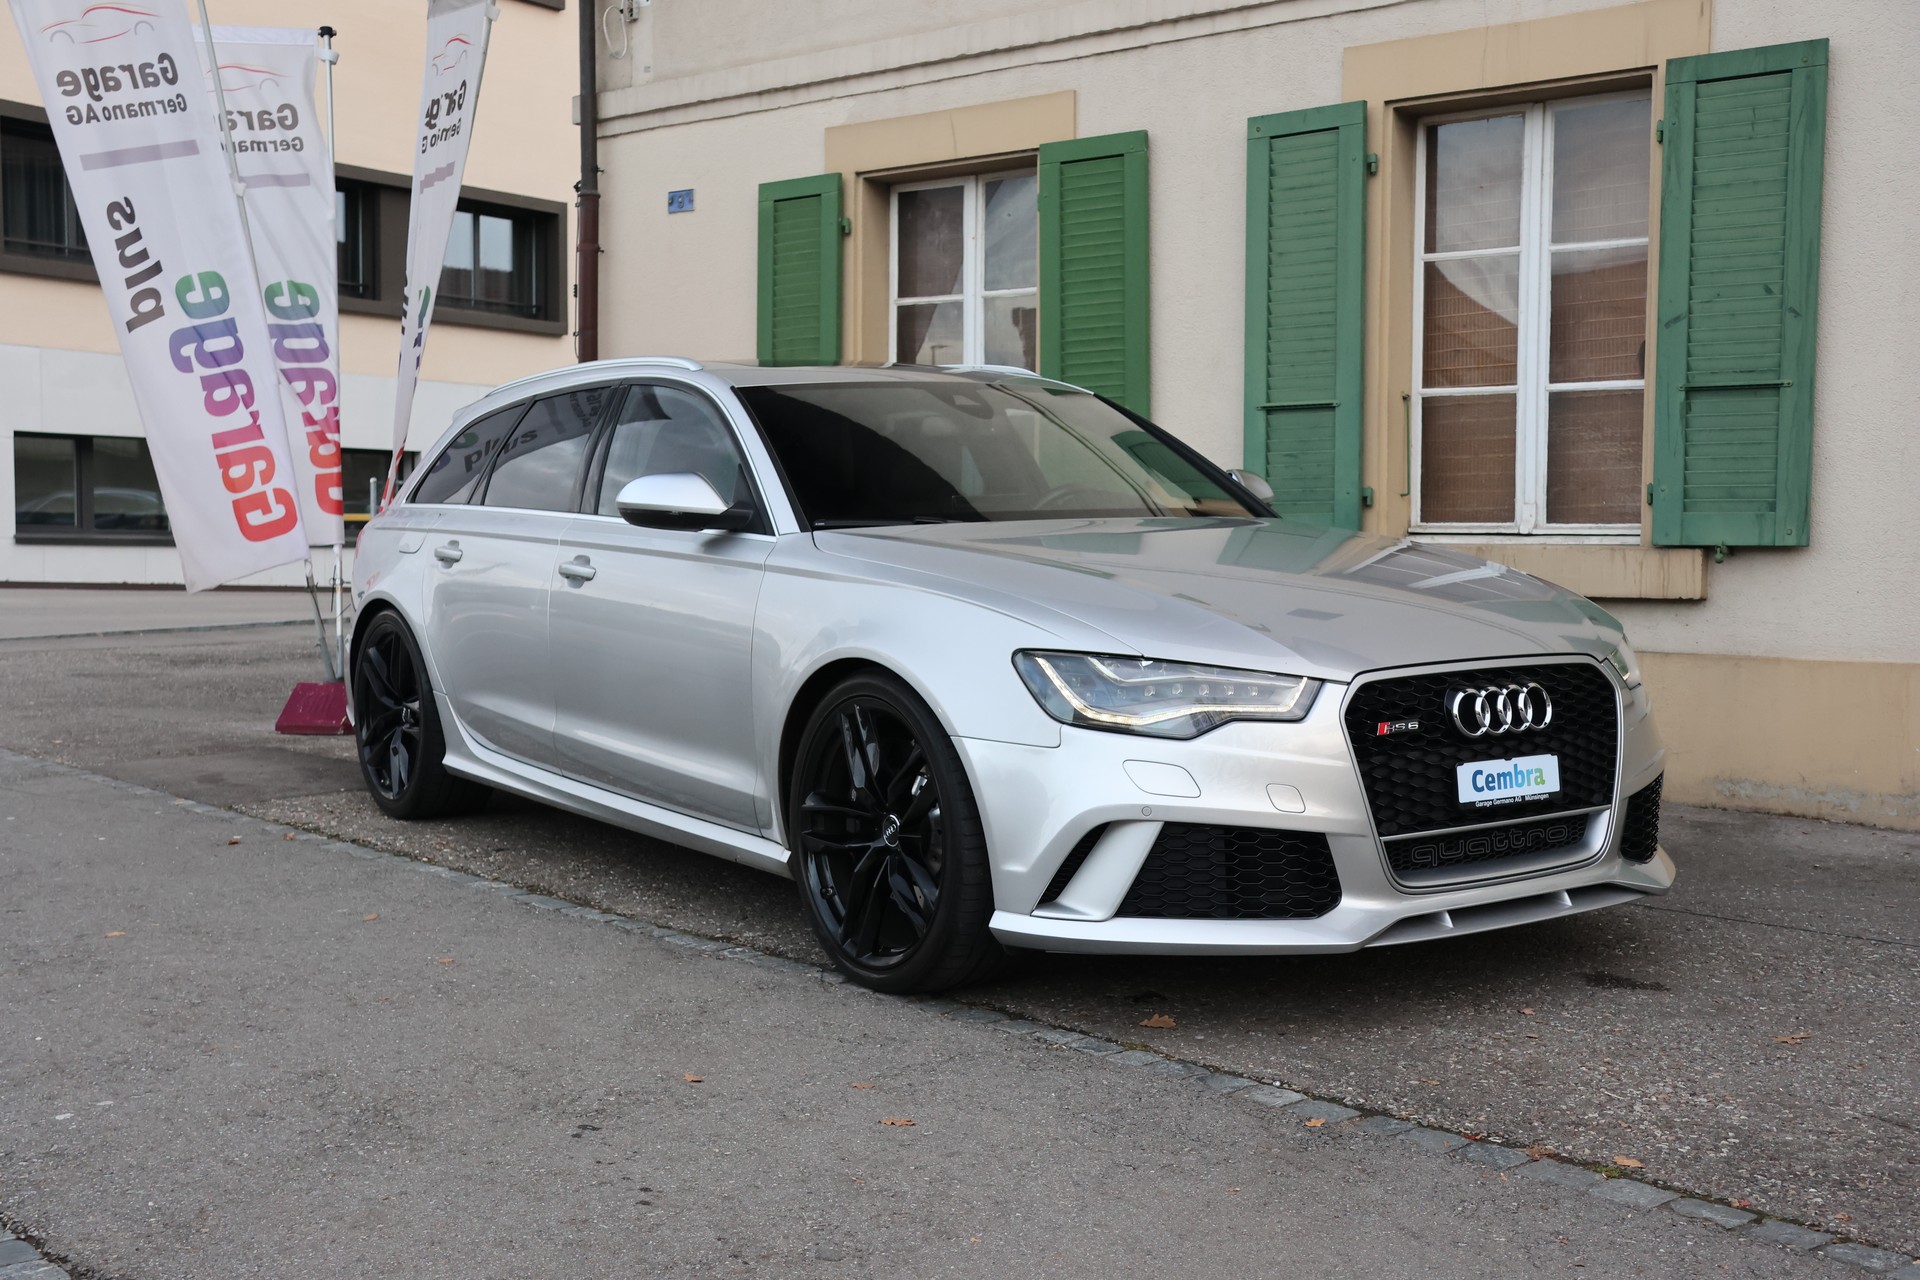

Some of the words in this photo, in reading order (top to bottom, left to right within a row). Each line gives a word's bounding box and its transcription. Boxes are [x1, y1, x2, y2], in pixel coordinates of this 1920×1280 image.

[1472, 764, 1546, 792] Cembra
[1475, 800, 1492, 808] Garage
[1412, 825, 1568, 866] quattro
